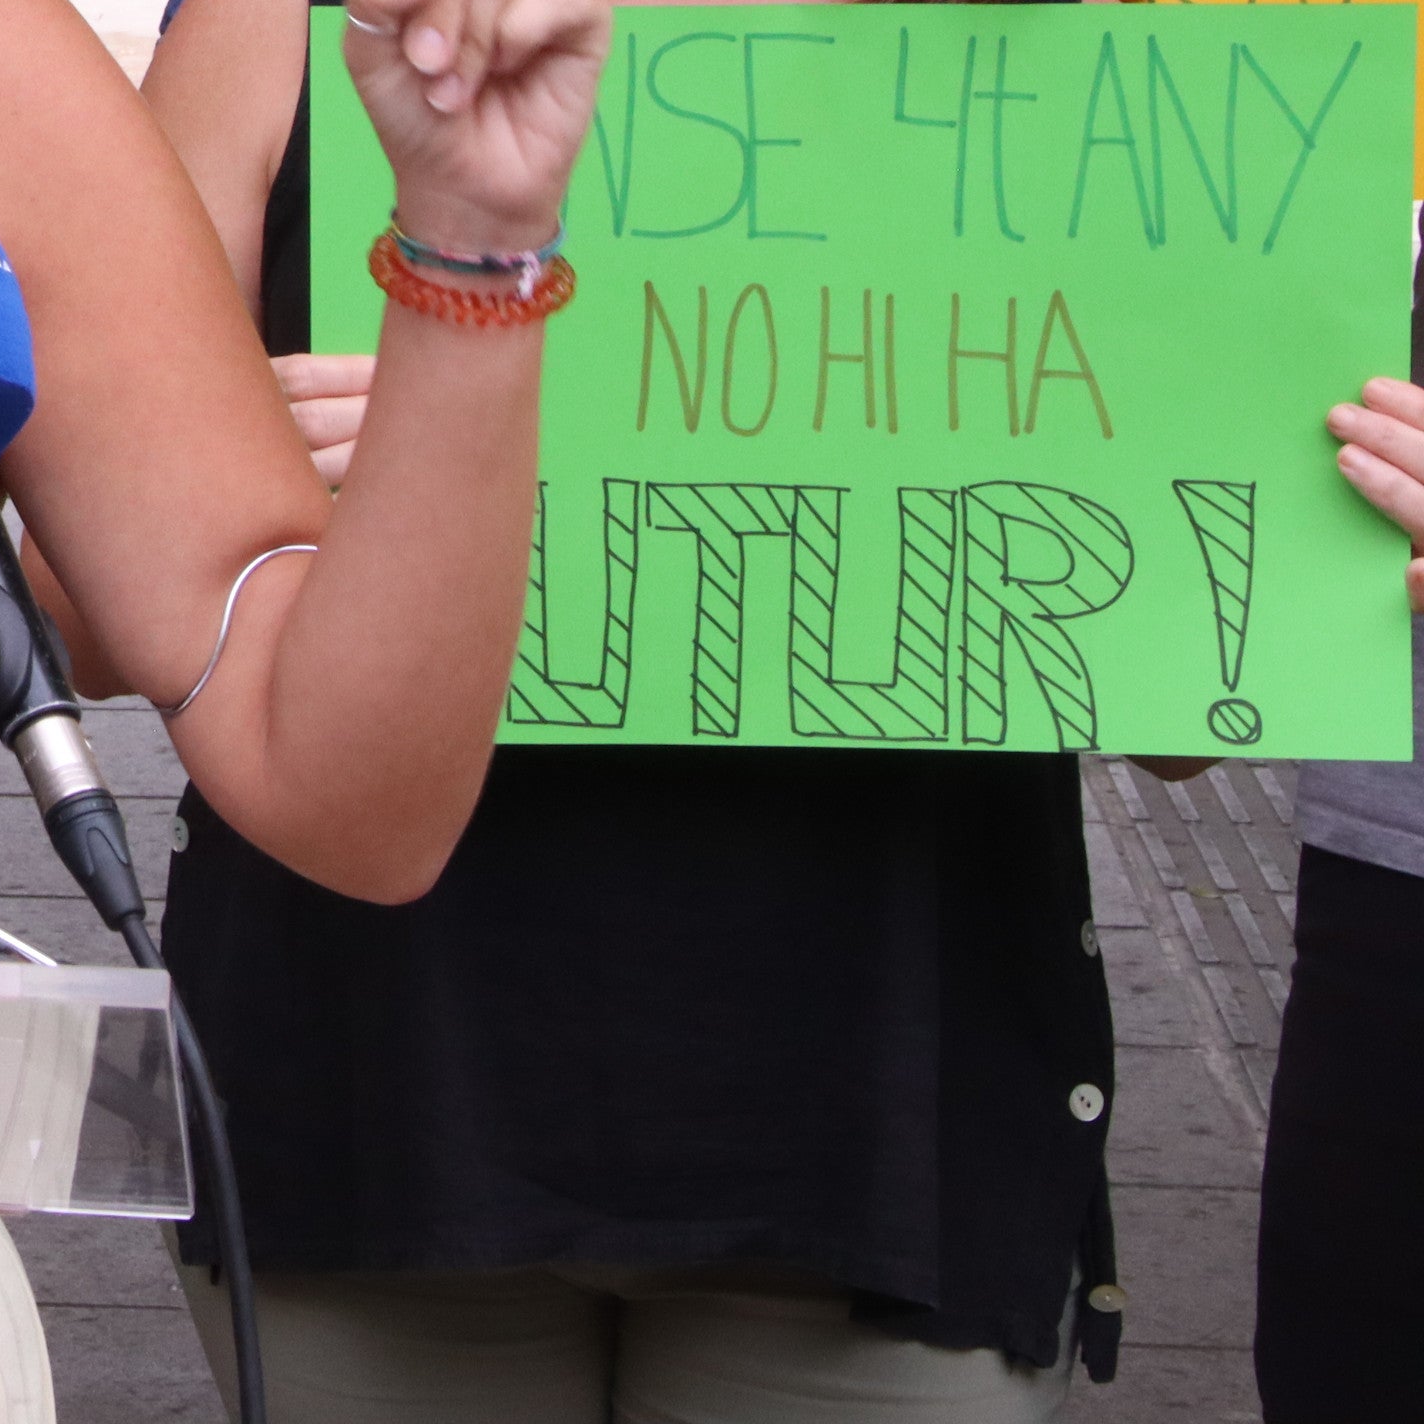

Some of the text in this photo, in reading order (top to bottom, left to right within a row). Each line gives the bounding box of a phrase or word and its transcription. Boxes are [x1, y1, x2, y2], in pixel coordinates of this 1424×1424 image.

[1069, 30, 1363, 255] ANY
[636, 280, 1114, 440] NO HI HA
[507, 478, 1263, 753] UTUR!
